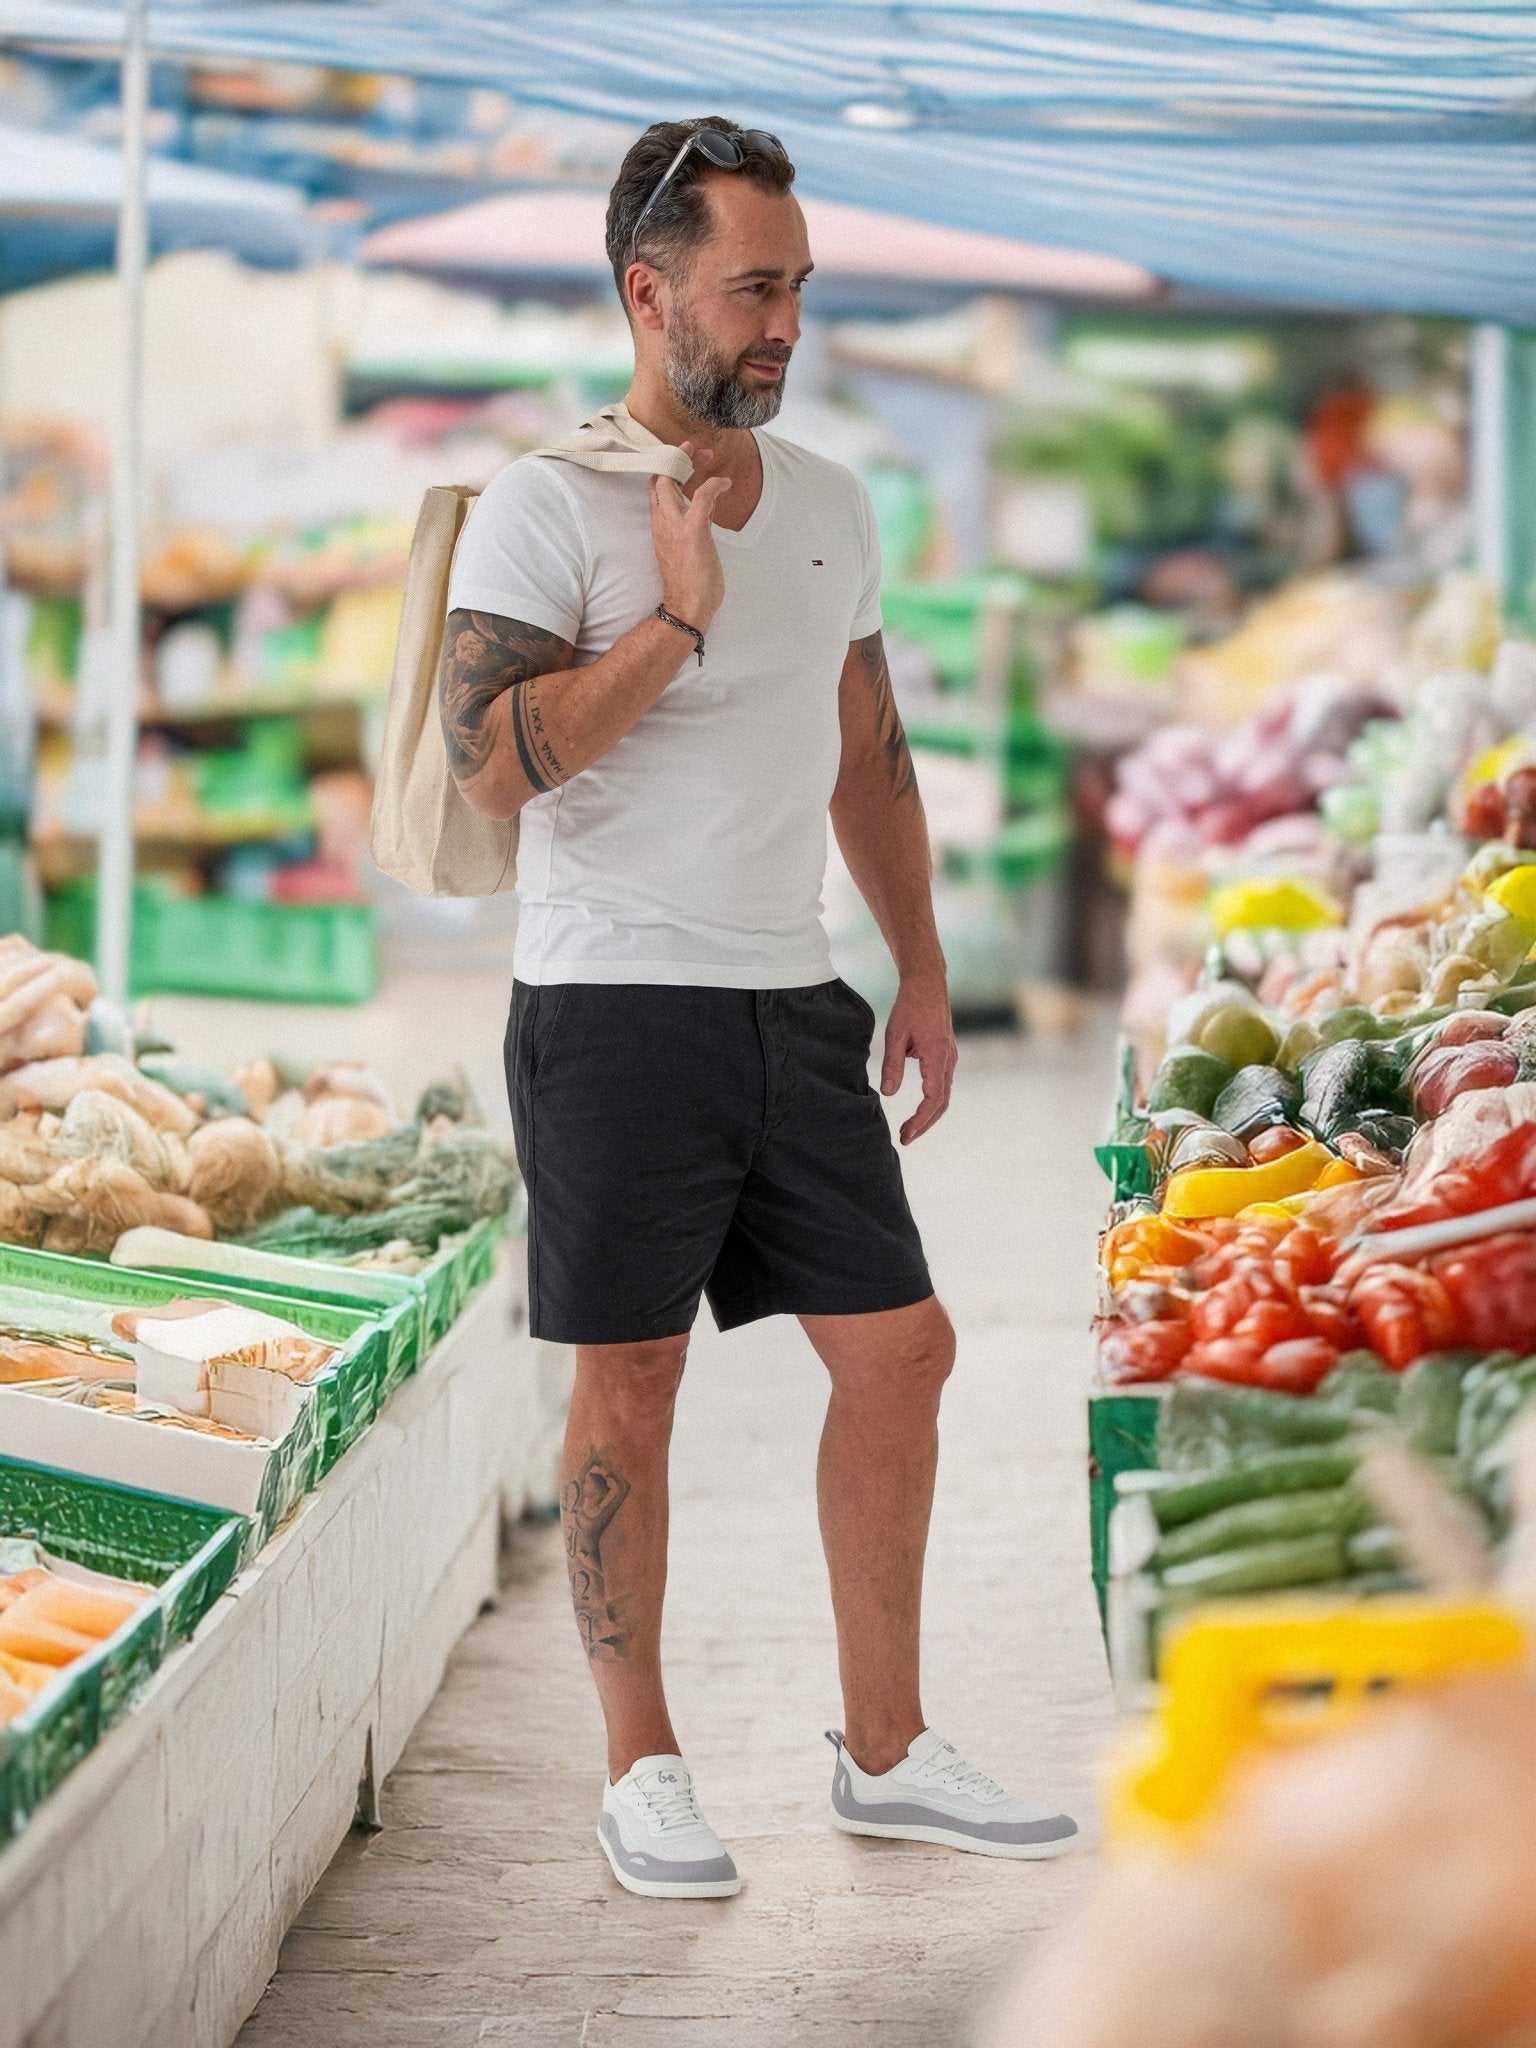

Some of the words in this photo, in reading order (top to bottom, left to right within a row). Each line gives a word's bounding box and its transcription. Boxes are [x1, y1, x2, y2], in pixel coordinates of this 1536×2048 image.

[531, 707, 545, 735] XXI
[542, 741, 564, 774] HANA
[658, 1771, 678, 1784] be
